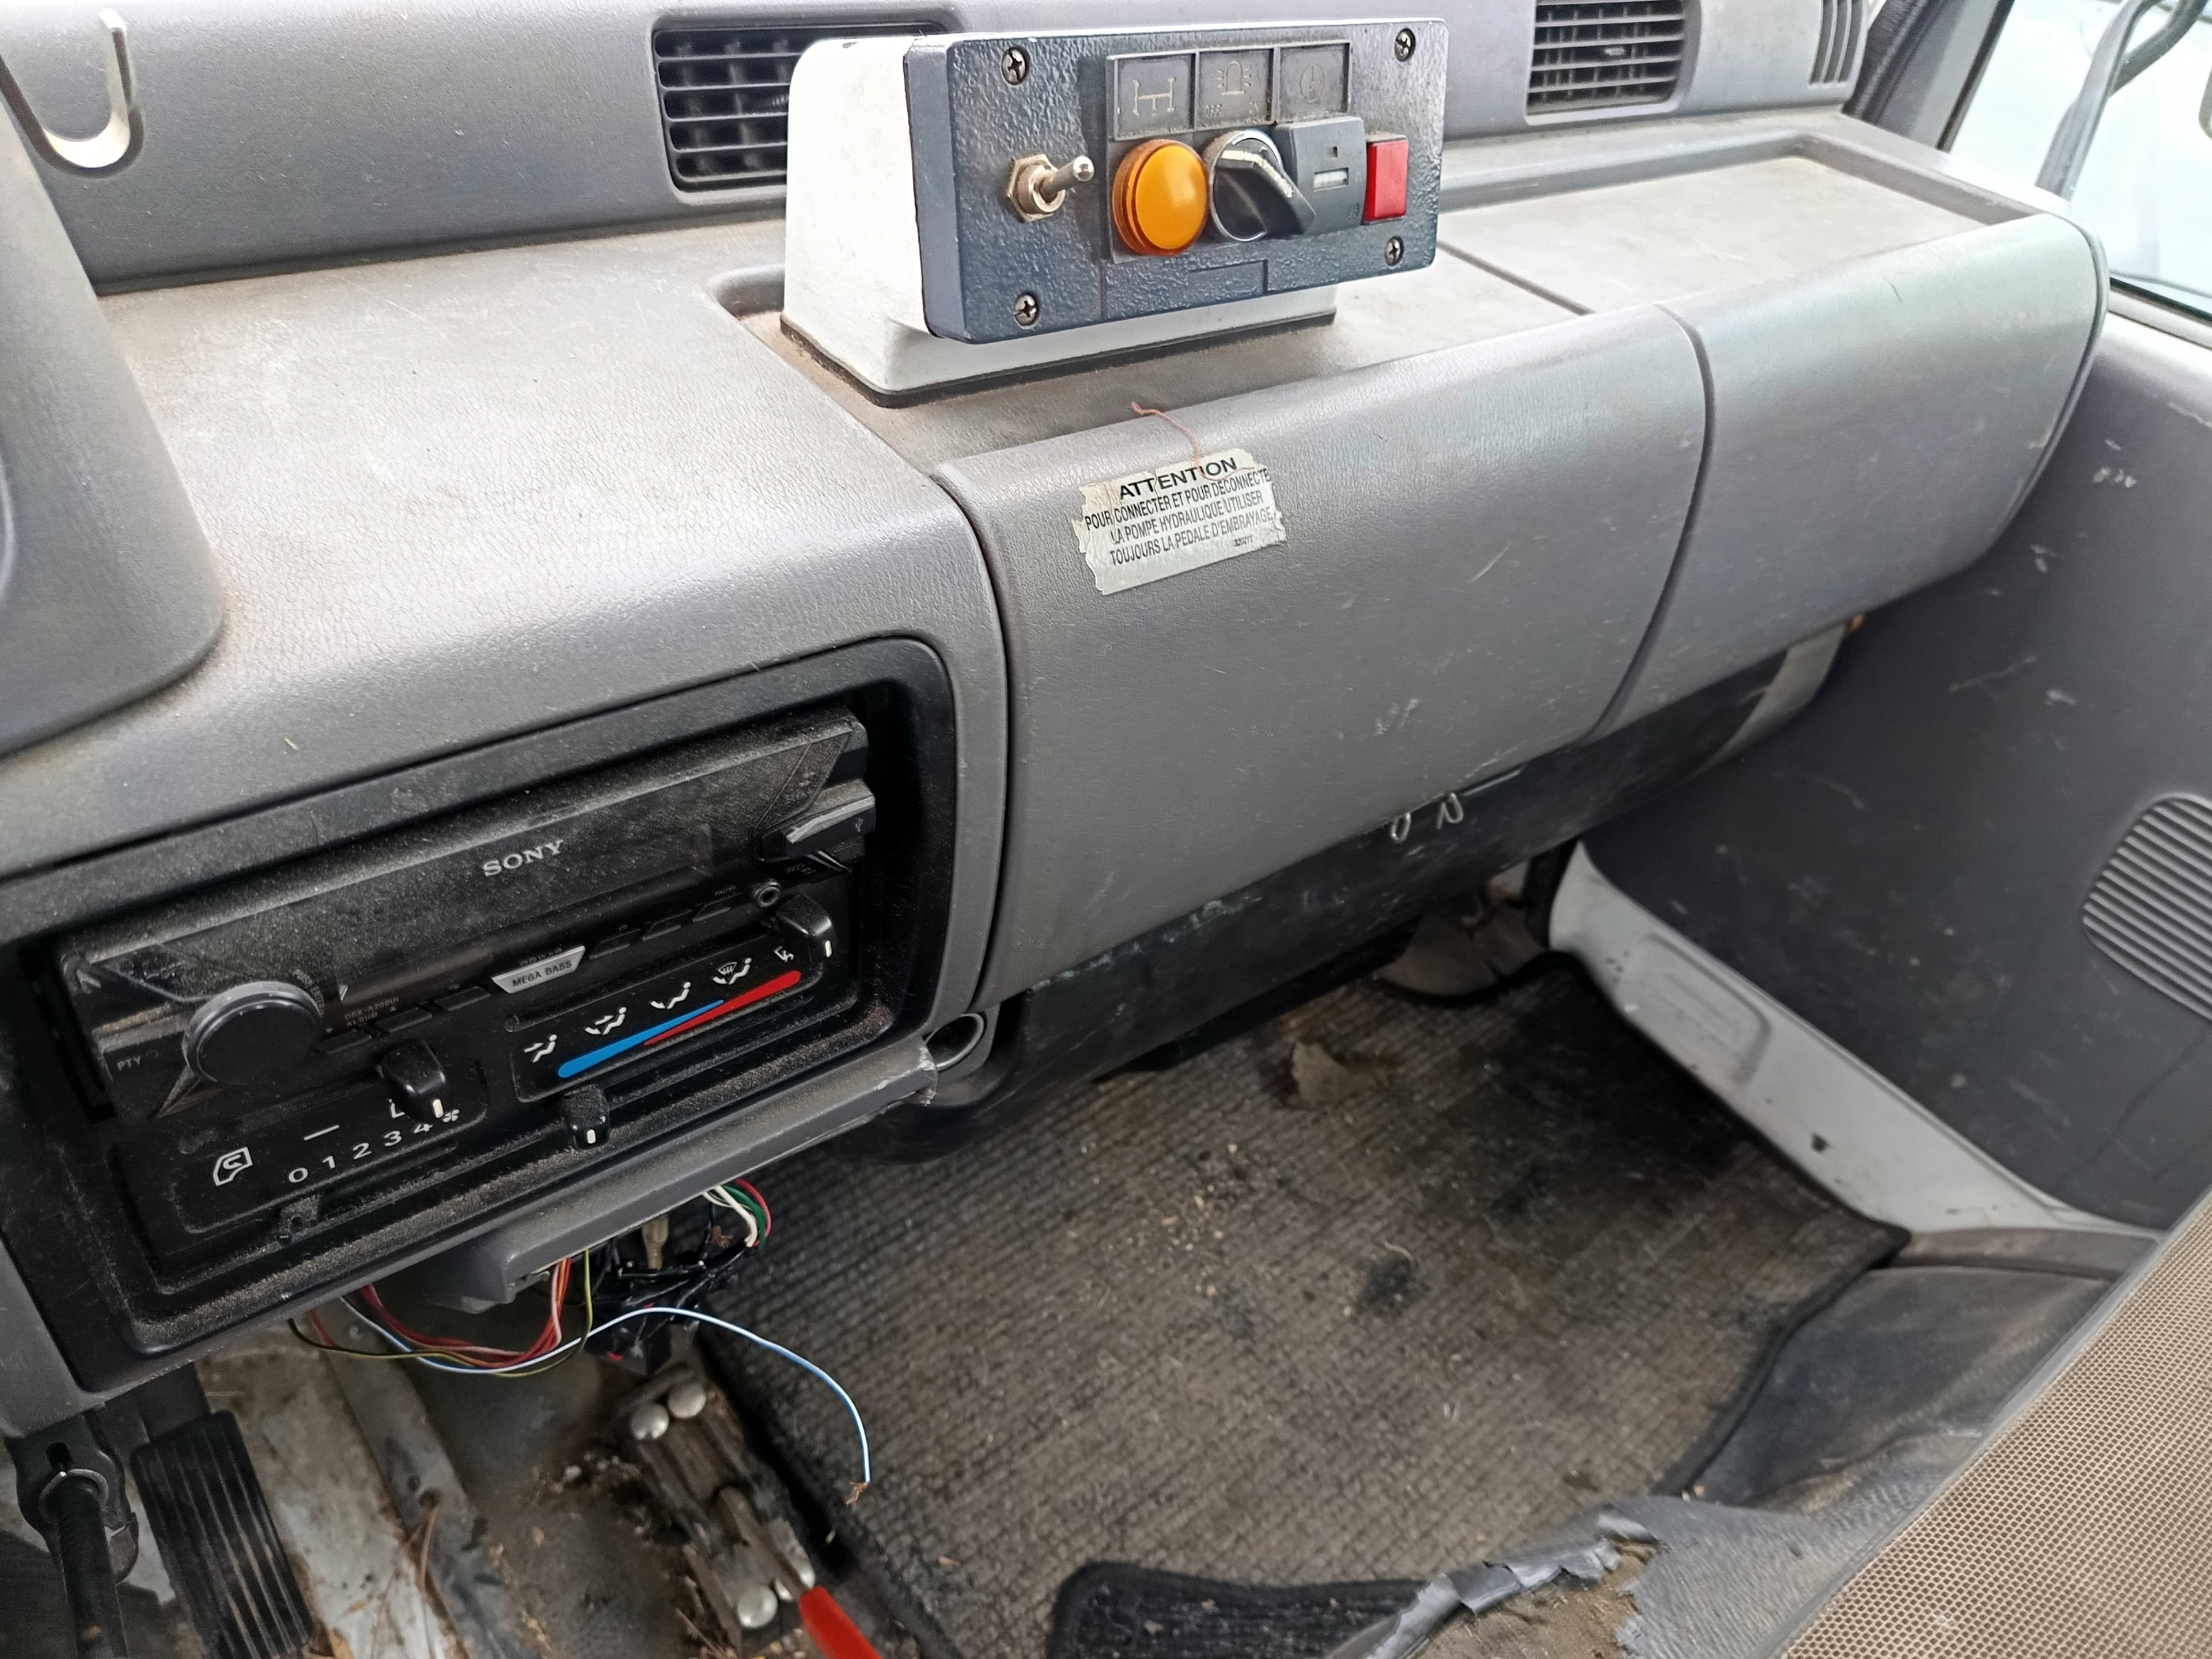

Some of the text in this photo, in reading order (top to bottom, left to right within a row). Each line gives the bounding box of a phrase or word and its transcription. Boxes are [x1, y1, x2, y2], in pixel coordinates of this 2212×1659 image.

[1120, 457, 1237, 500] ATTENTION
[1085, 510, 1112, 531] POUR
[1114, 495, 1171, 523] CONNECTER
[1171, 491, 1184, 508] ET
[1184, 484, 1211, 504] POUR
[1110, 490, 1264, 545] LA POMPE HYDRAULIQUE UTILISER
[1109, 506, 1273, 566] TOUJOURS LA PEDALE D'EMBRAYAGE
[483, 839, 563, 877] SONY
[512, 960, 572, 987] MEGA BASS
[117, 1056, 141, 1071] PTY
[289, 1167, 308, 1183] 0
[322, 1156, 336, 1169] 1
[352, 1142, 372, 1160] 2
[383, 1130, 403, 1147] 3
